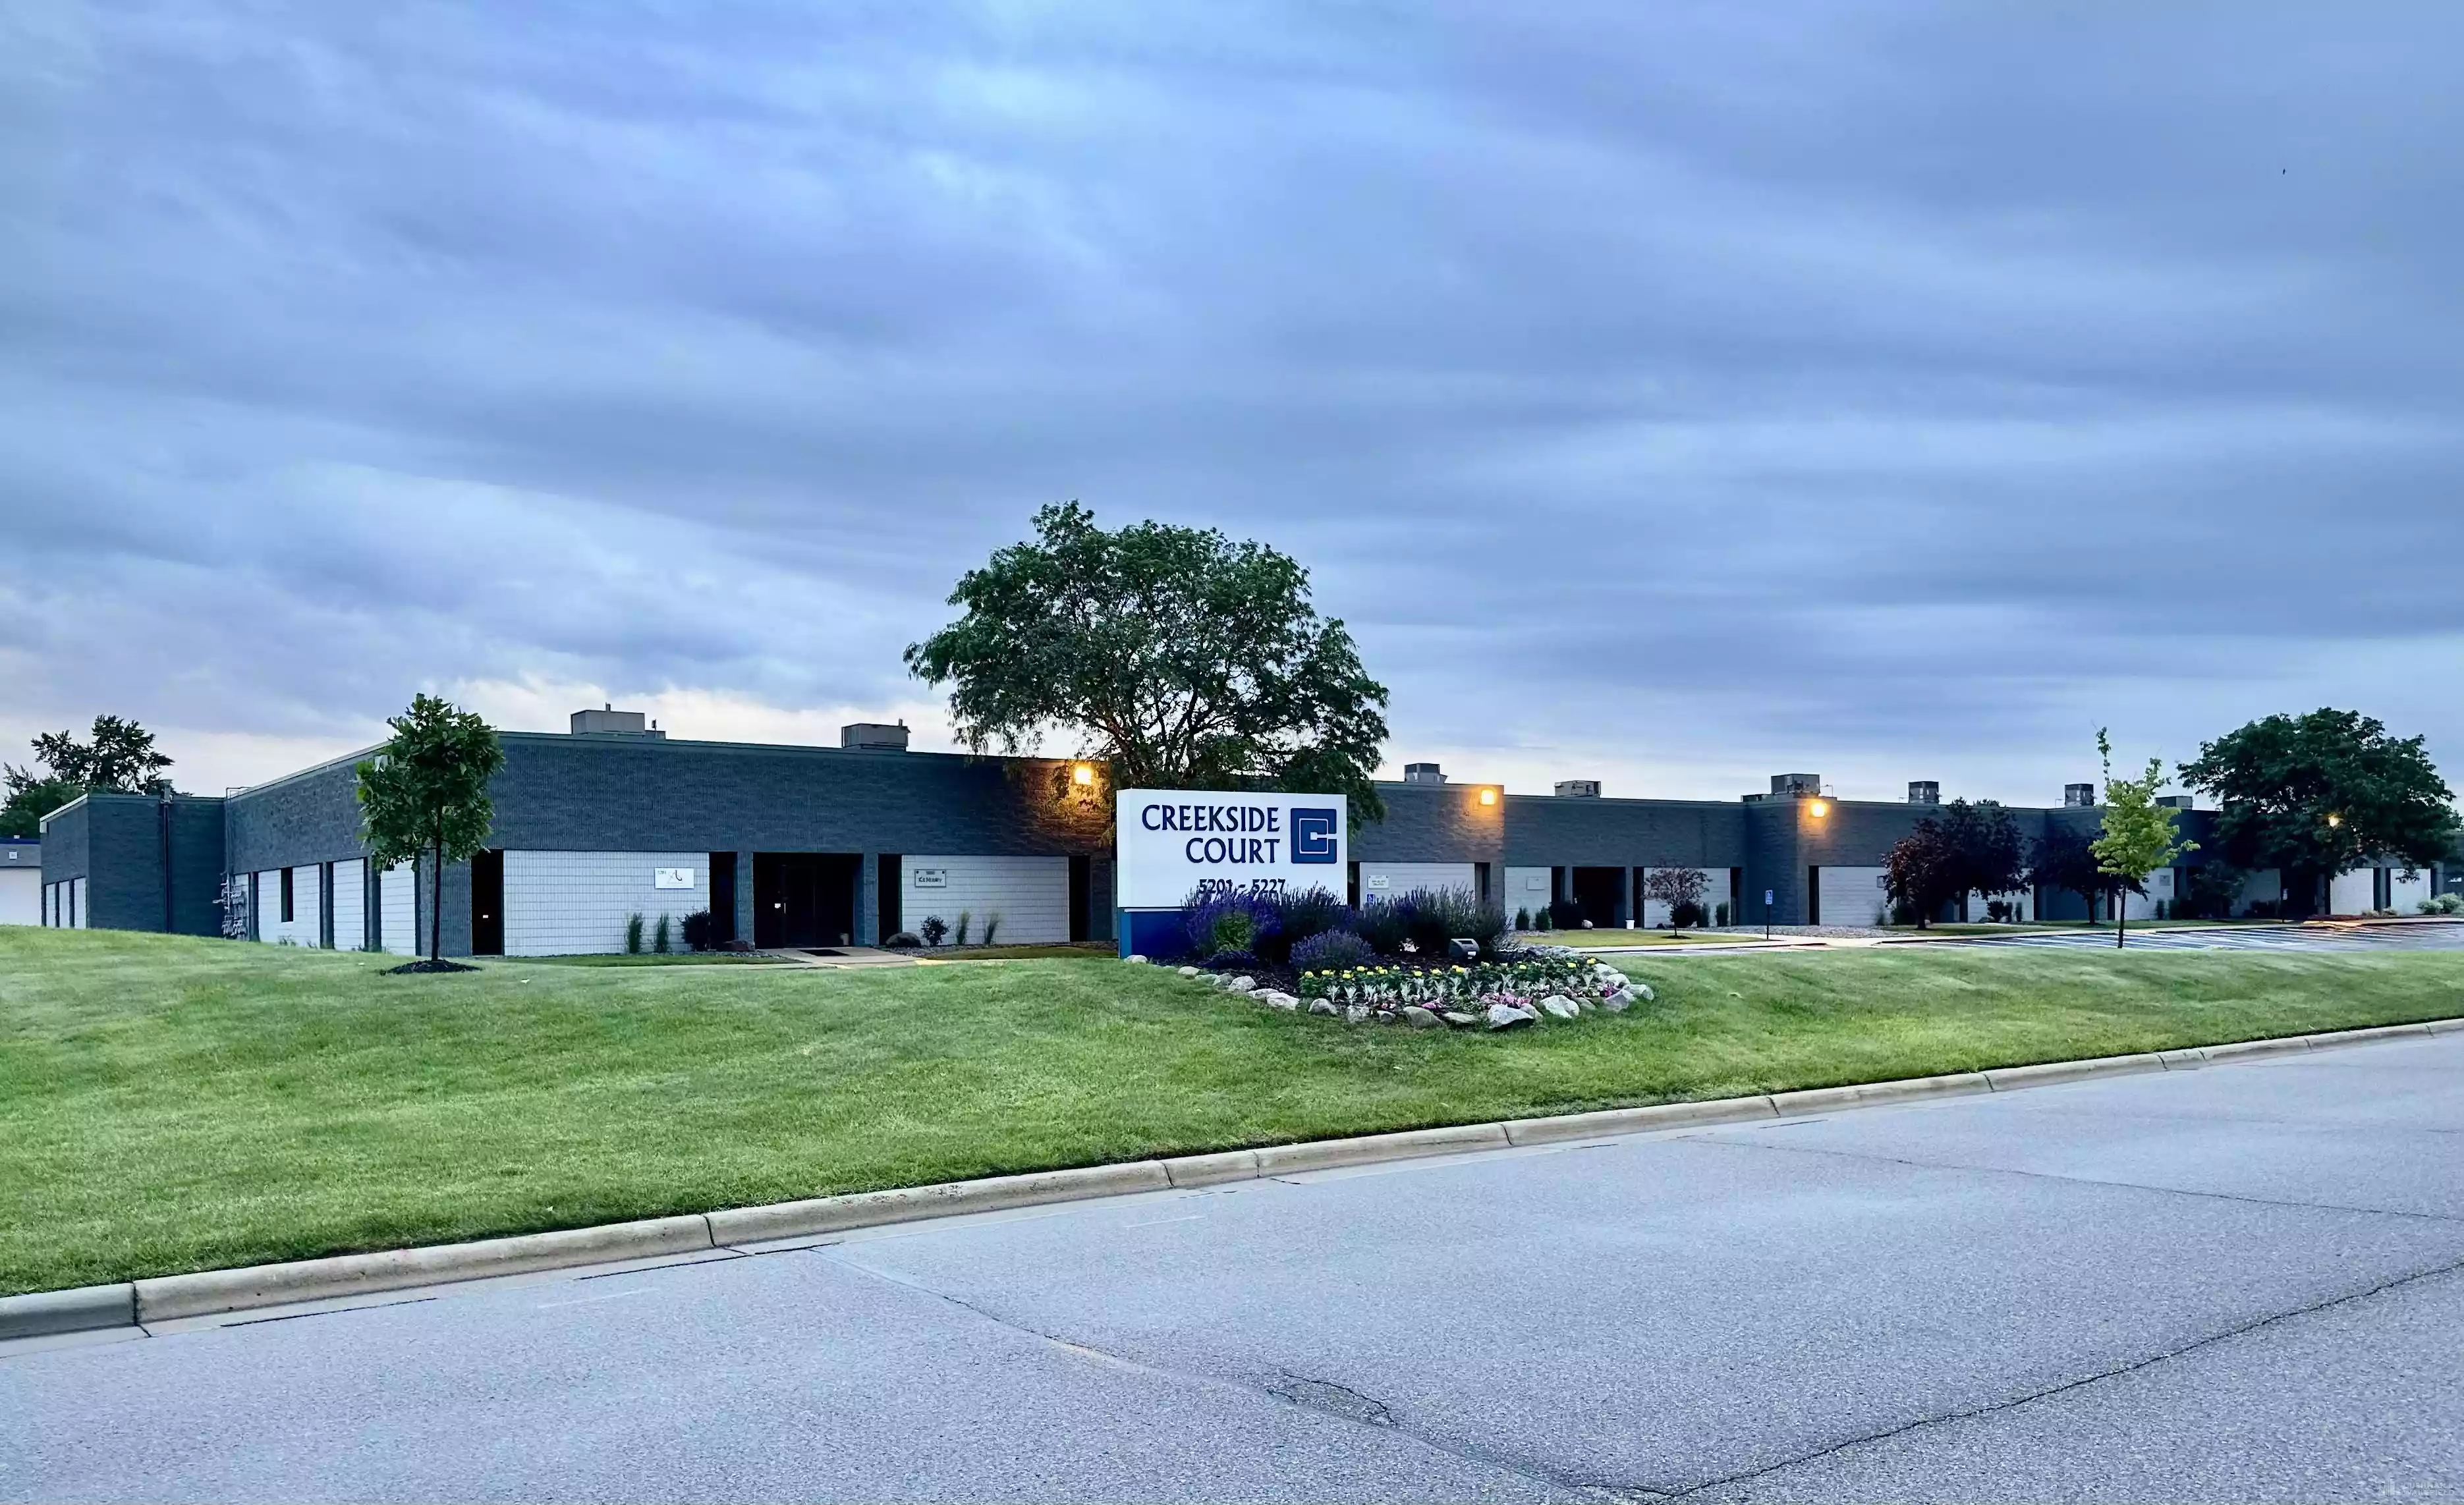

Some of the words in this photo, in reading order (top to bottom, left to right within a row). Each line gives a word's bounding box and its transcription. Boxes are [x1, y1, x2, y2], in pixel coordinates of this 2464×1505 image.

[1142, 804, 1281, 833] CREEKSIDE
[1185, 837, 1281, 864] COURT
[1199, 879, 1233, 894] 5201
[1252, 879, 1285, 894] 5227
